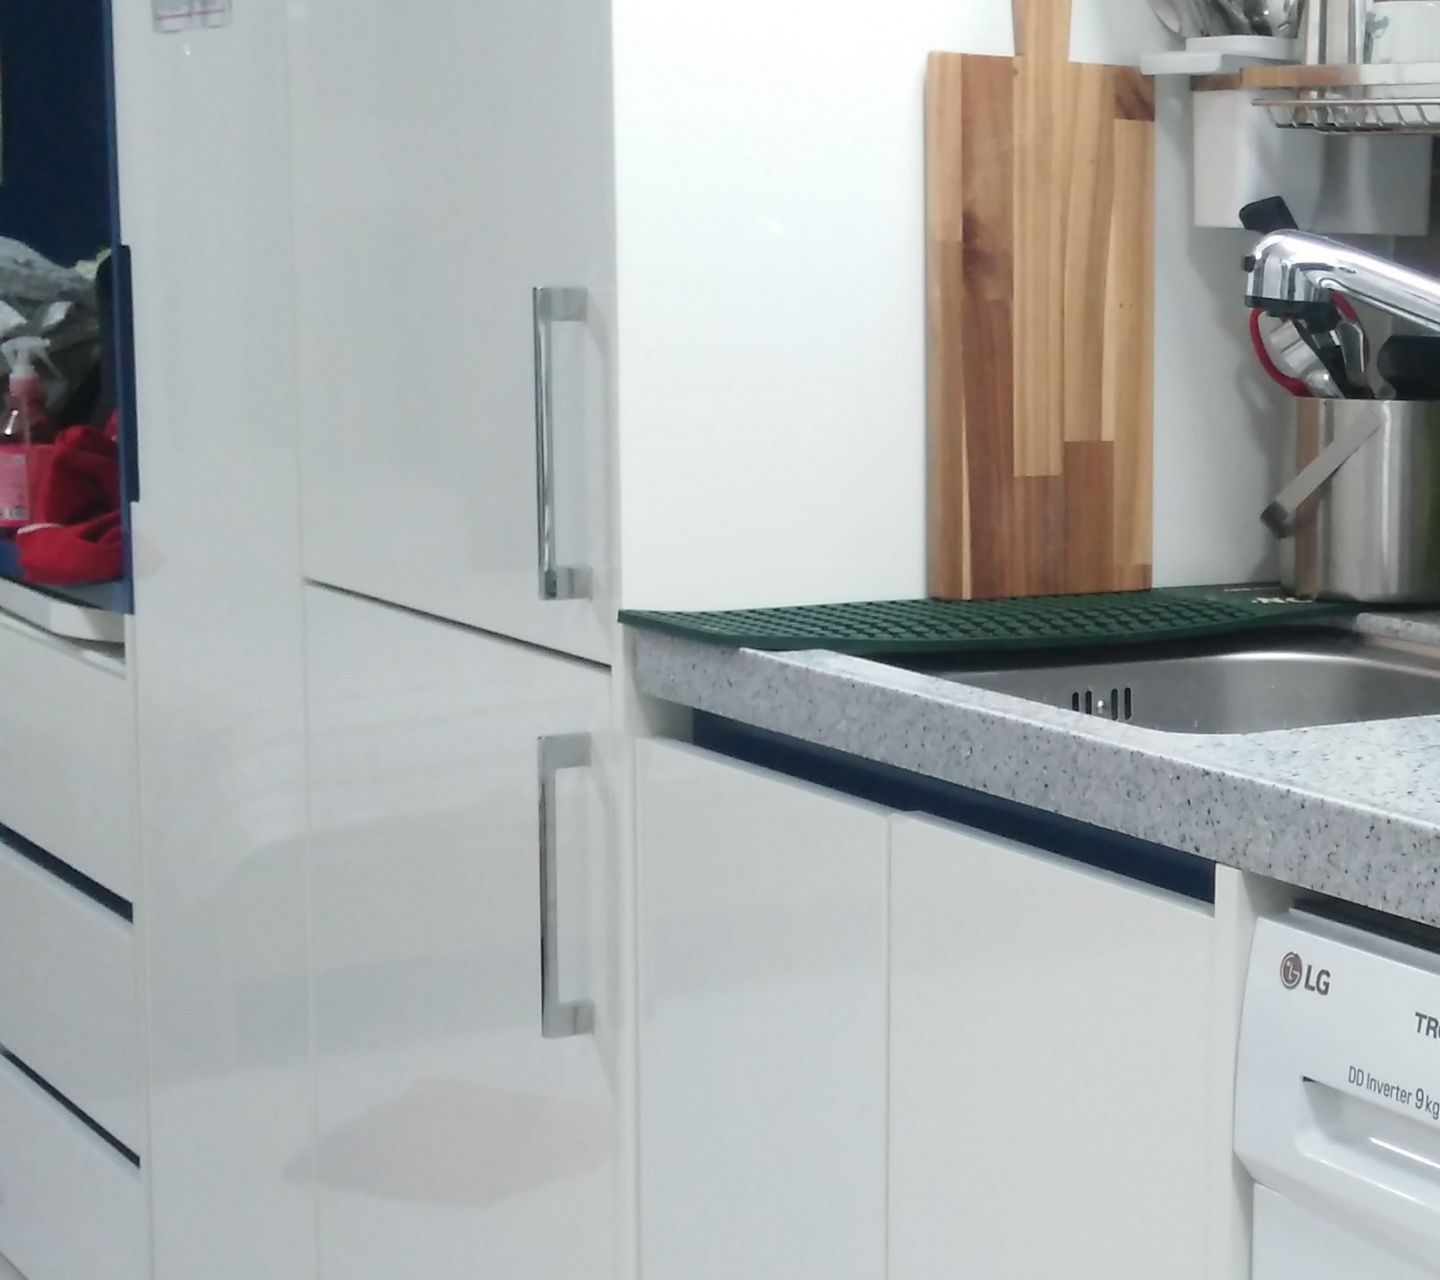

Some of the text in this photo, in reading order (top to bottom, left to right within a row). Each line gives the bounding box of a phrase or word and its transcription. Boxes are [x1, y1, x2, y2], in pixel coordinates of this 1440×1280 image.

[1303, 964, 1331, 996] LG
[1347, 1066, 1365, 1087] DD
[1366, 1071, 1413, 1105] Inverter
